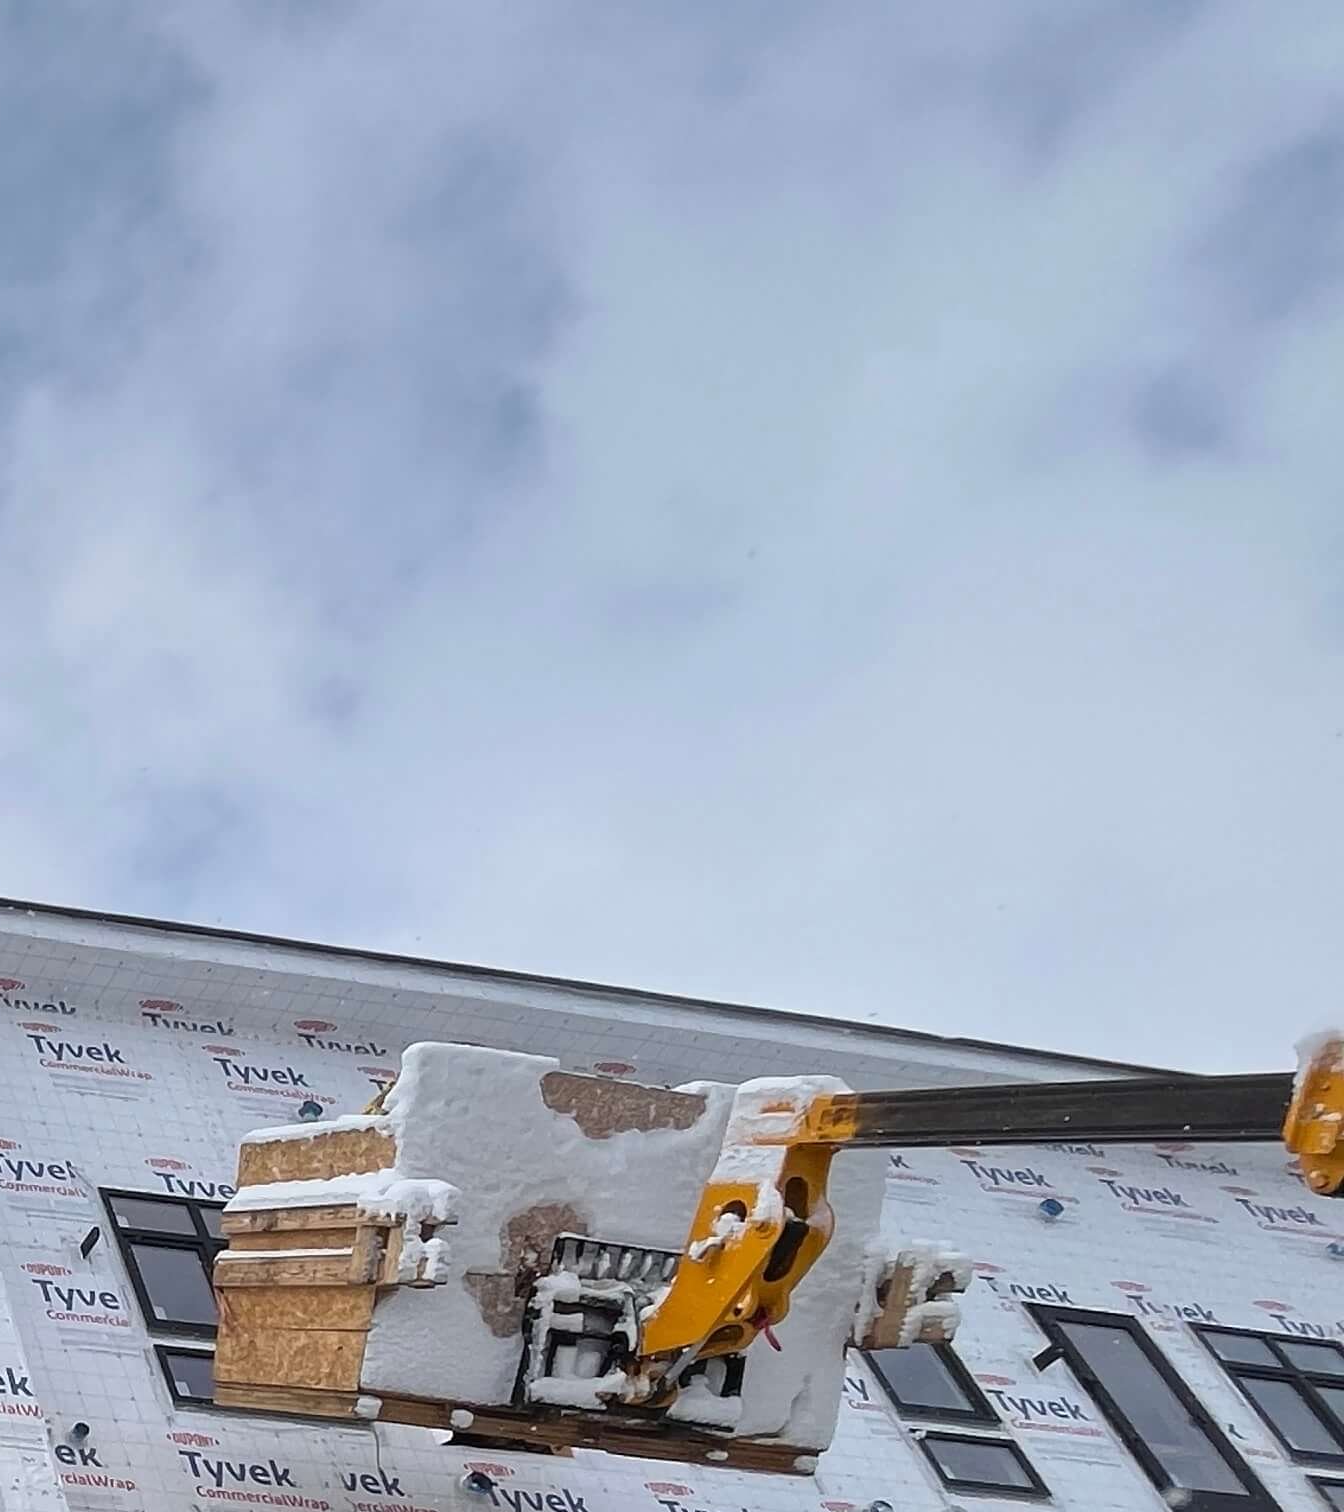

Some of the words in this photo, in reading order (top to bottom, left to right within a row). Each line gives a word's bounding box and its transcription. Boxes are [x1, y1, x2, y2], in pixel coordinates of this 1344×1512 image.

[27, 1033, 124, 1064] Tyvek
[214, 1058, 307, 1088] Tyvek
[962, 1159, 1050, 1188] Tyvek
[1101, 1179, 1190, 1209] Tyvek
[1236, 1199, 1323, 1227] Tyvek
[32, 1279, 120, 1311] Tyve
[990, 1389, 1088, 1422] Tyvek
[180, 1450, 295, 1488] Tyvek
[196, 1485, 330, 1512] CommercialWrap
